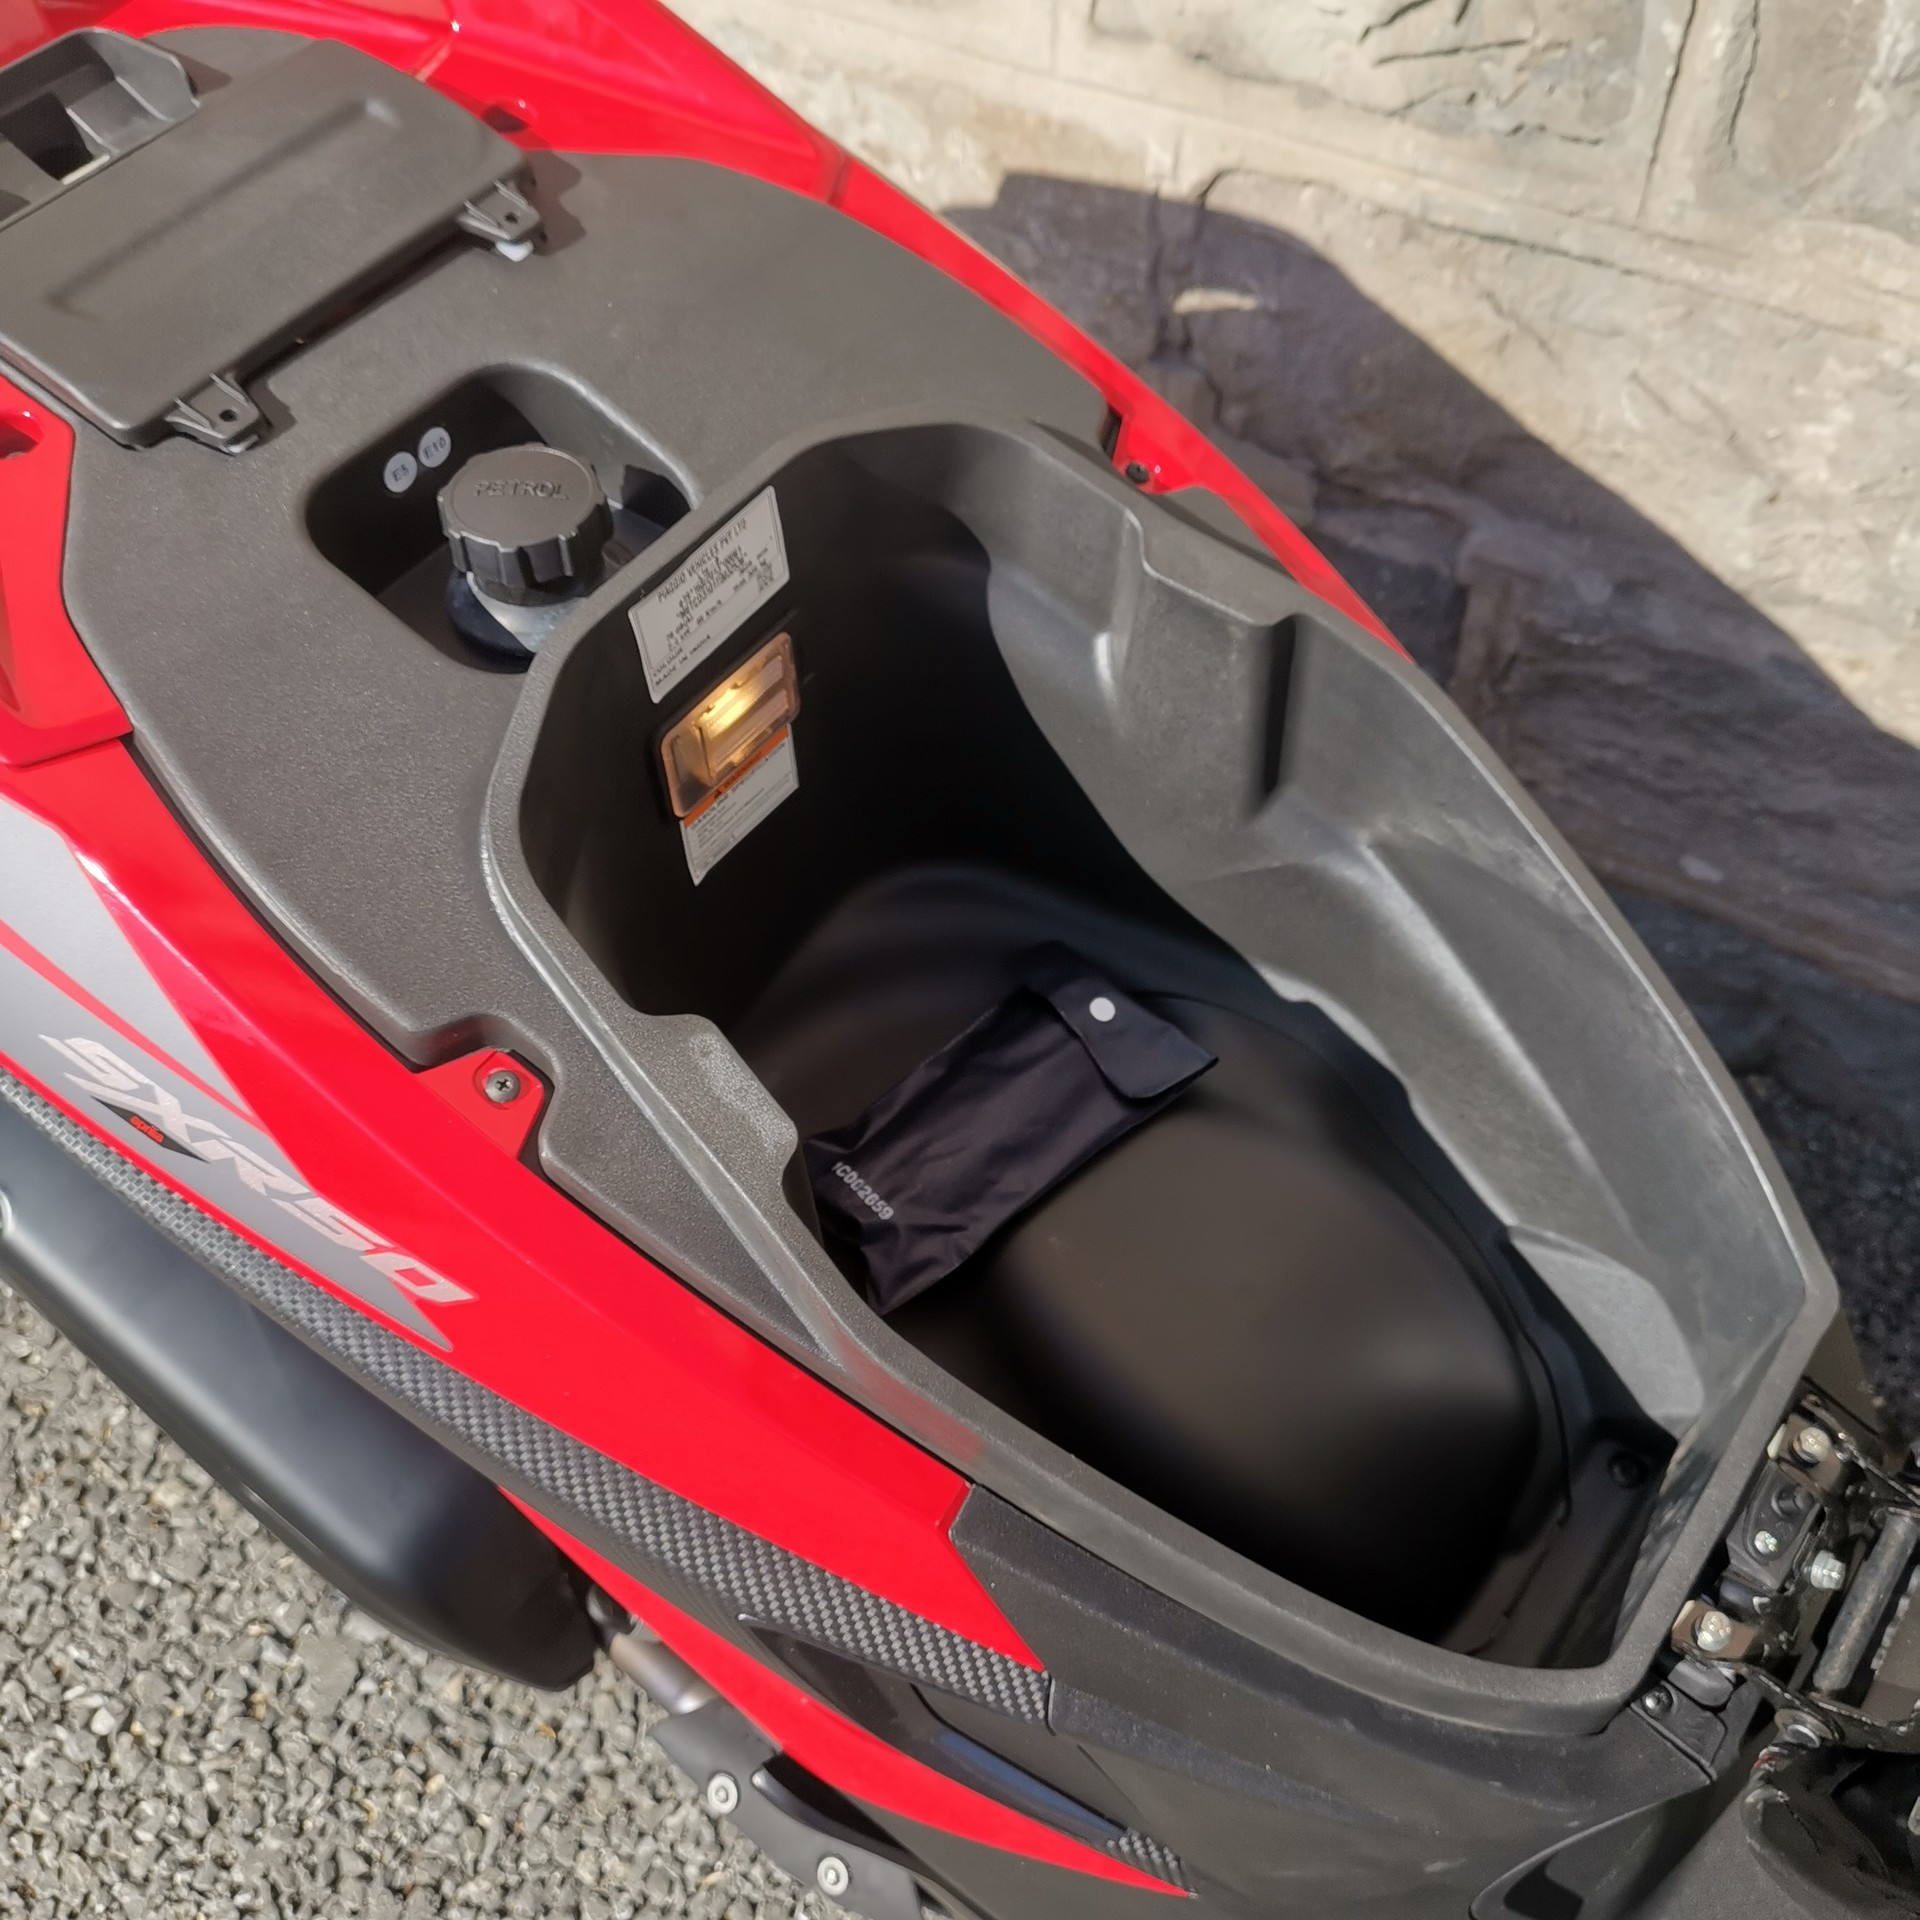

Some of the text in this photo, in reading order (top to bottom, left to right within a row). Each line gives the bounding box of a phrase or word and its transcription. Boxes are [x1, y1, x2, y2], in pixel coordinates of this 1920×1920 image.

[422, 436, 447, 460] E10
[391, 463, 410, 482] E5
[474, 479, 570, 501] PETROL
[130, 1115, 164, 1144] aprilia
